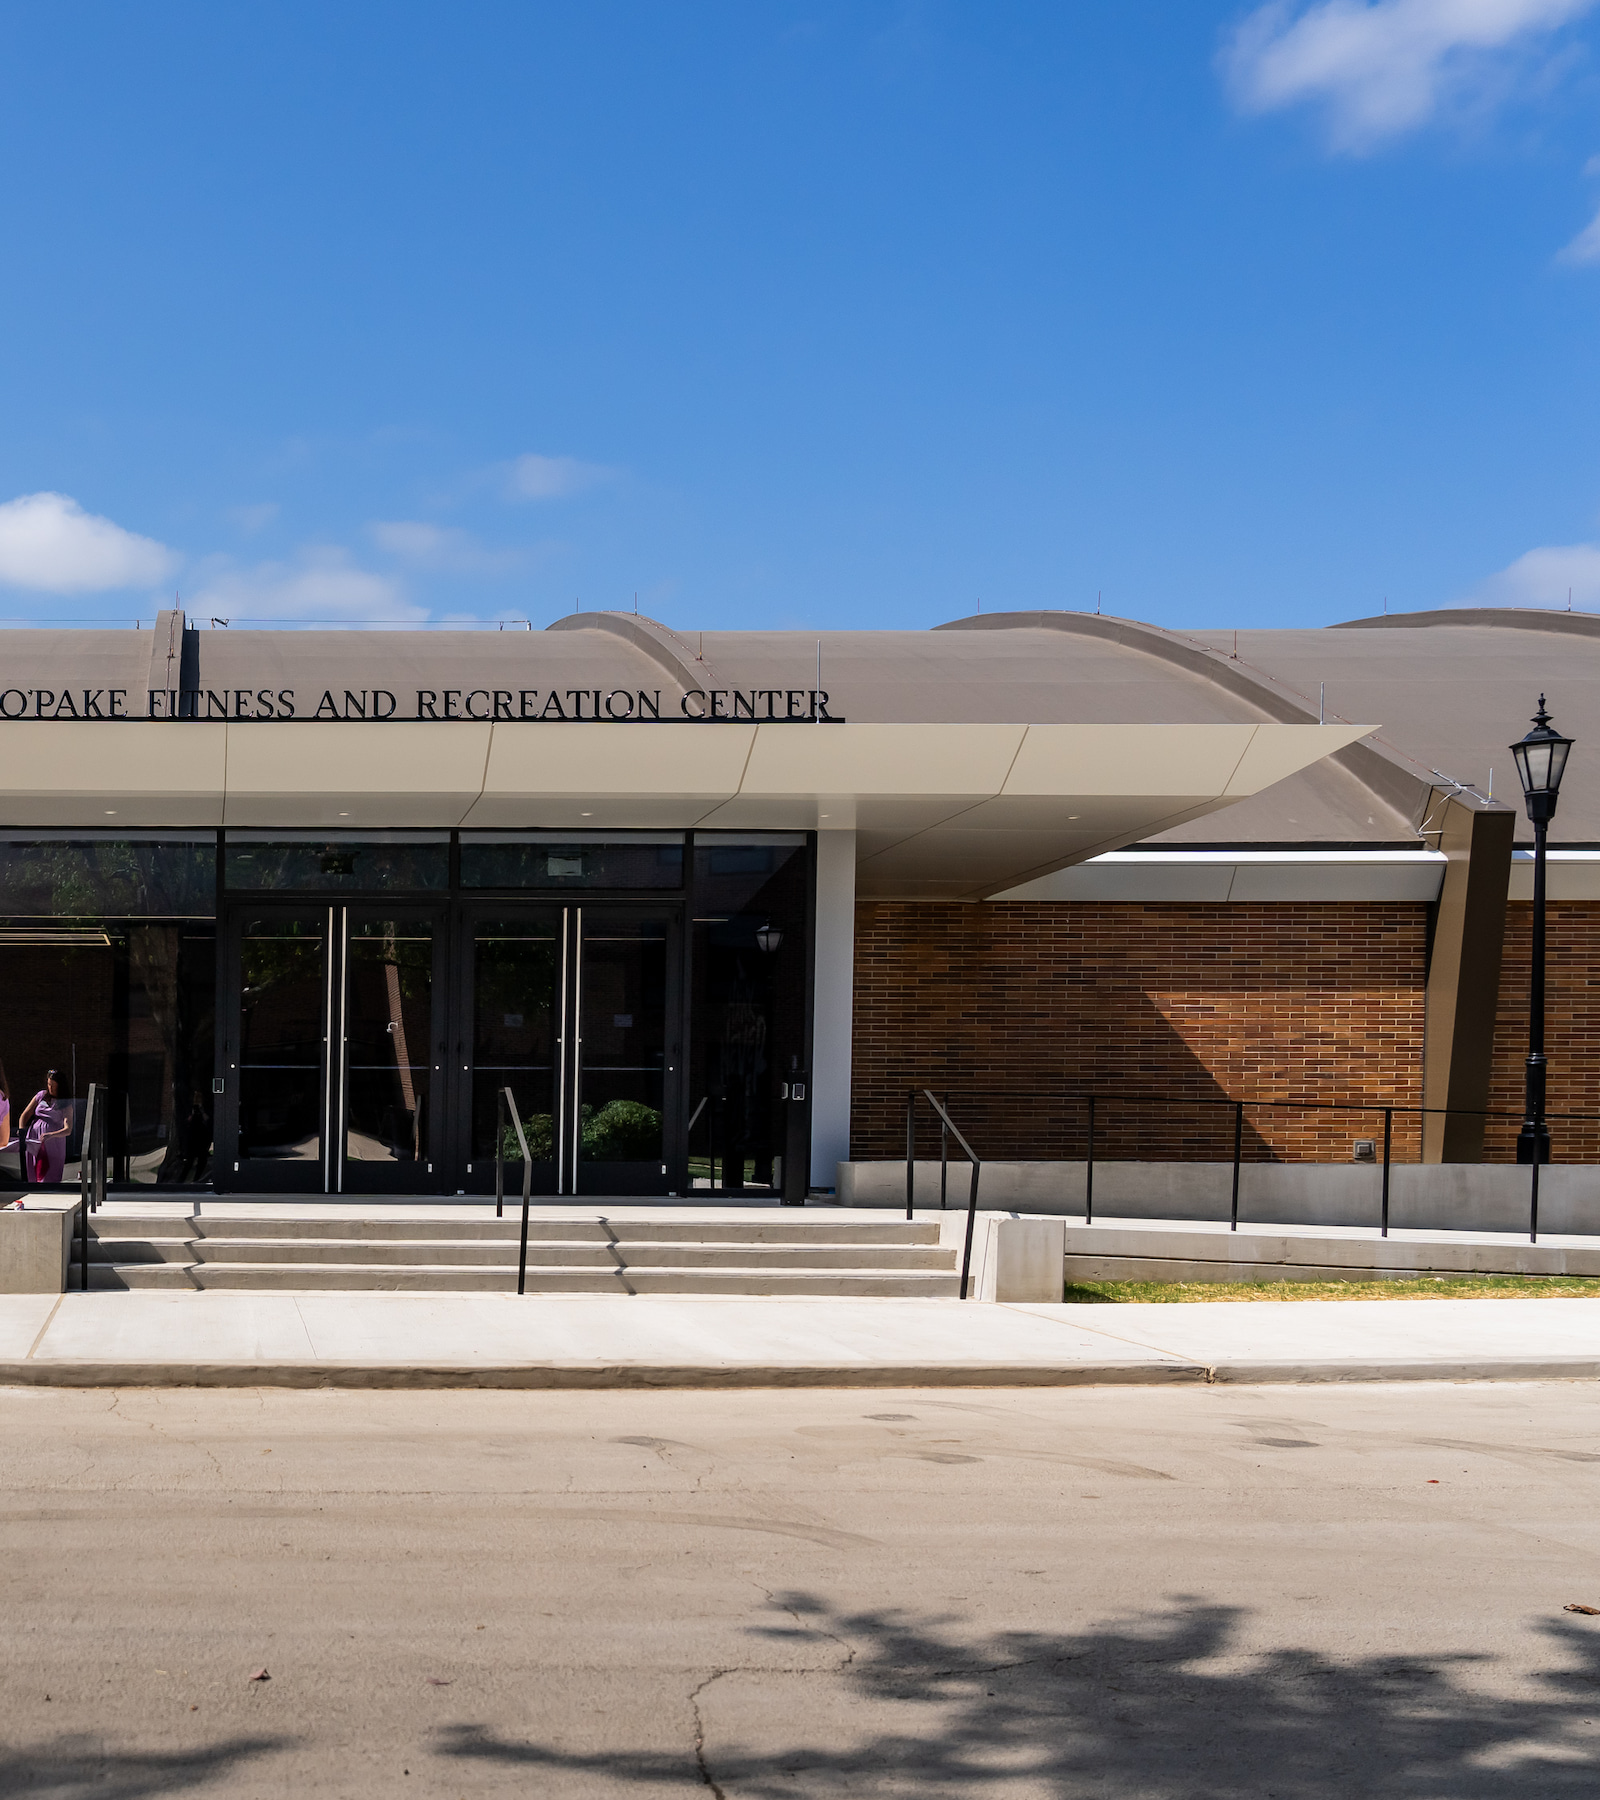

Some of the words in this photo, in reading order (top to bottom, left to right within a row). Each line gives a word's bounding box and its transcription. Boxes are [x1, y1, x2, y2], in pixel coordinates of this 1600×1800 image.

[0, 689, 128, 718] O'PAKE
[148, 689, 295, 718] FITNESS
[314, 689, 397, 718] AND
[416, 690, 662, 718] RECREATION
[681, 690, 833, 718] CENTER
